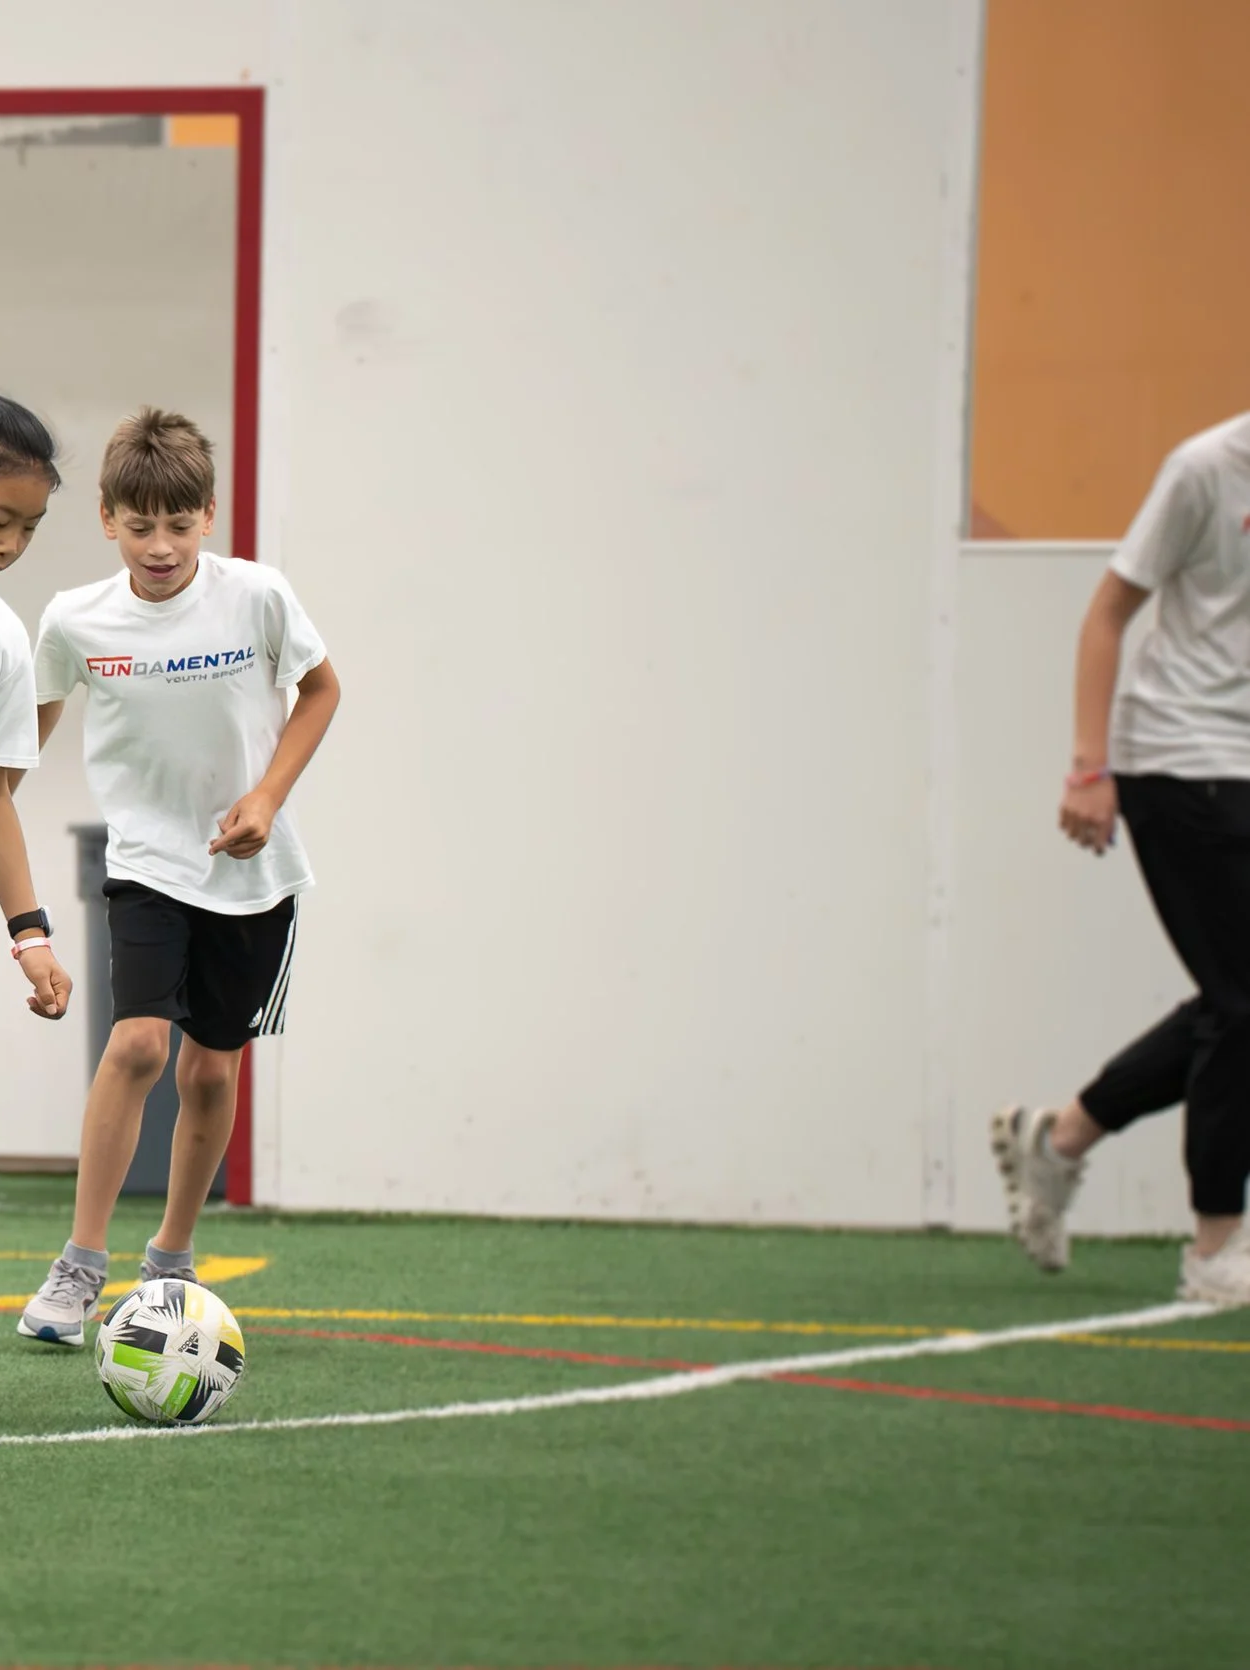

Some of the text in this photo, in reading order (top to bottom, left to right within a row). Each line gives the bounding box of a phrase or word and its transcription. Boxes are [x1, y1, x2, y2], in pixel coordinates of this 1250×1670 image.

[86, 646, 255, 677] FUNDAMENTAL
[165, 661, 255, 684] YOUTH SPORTS
